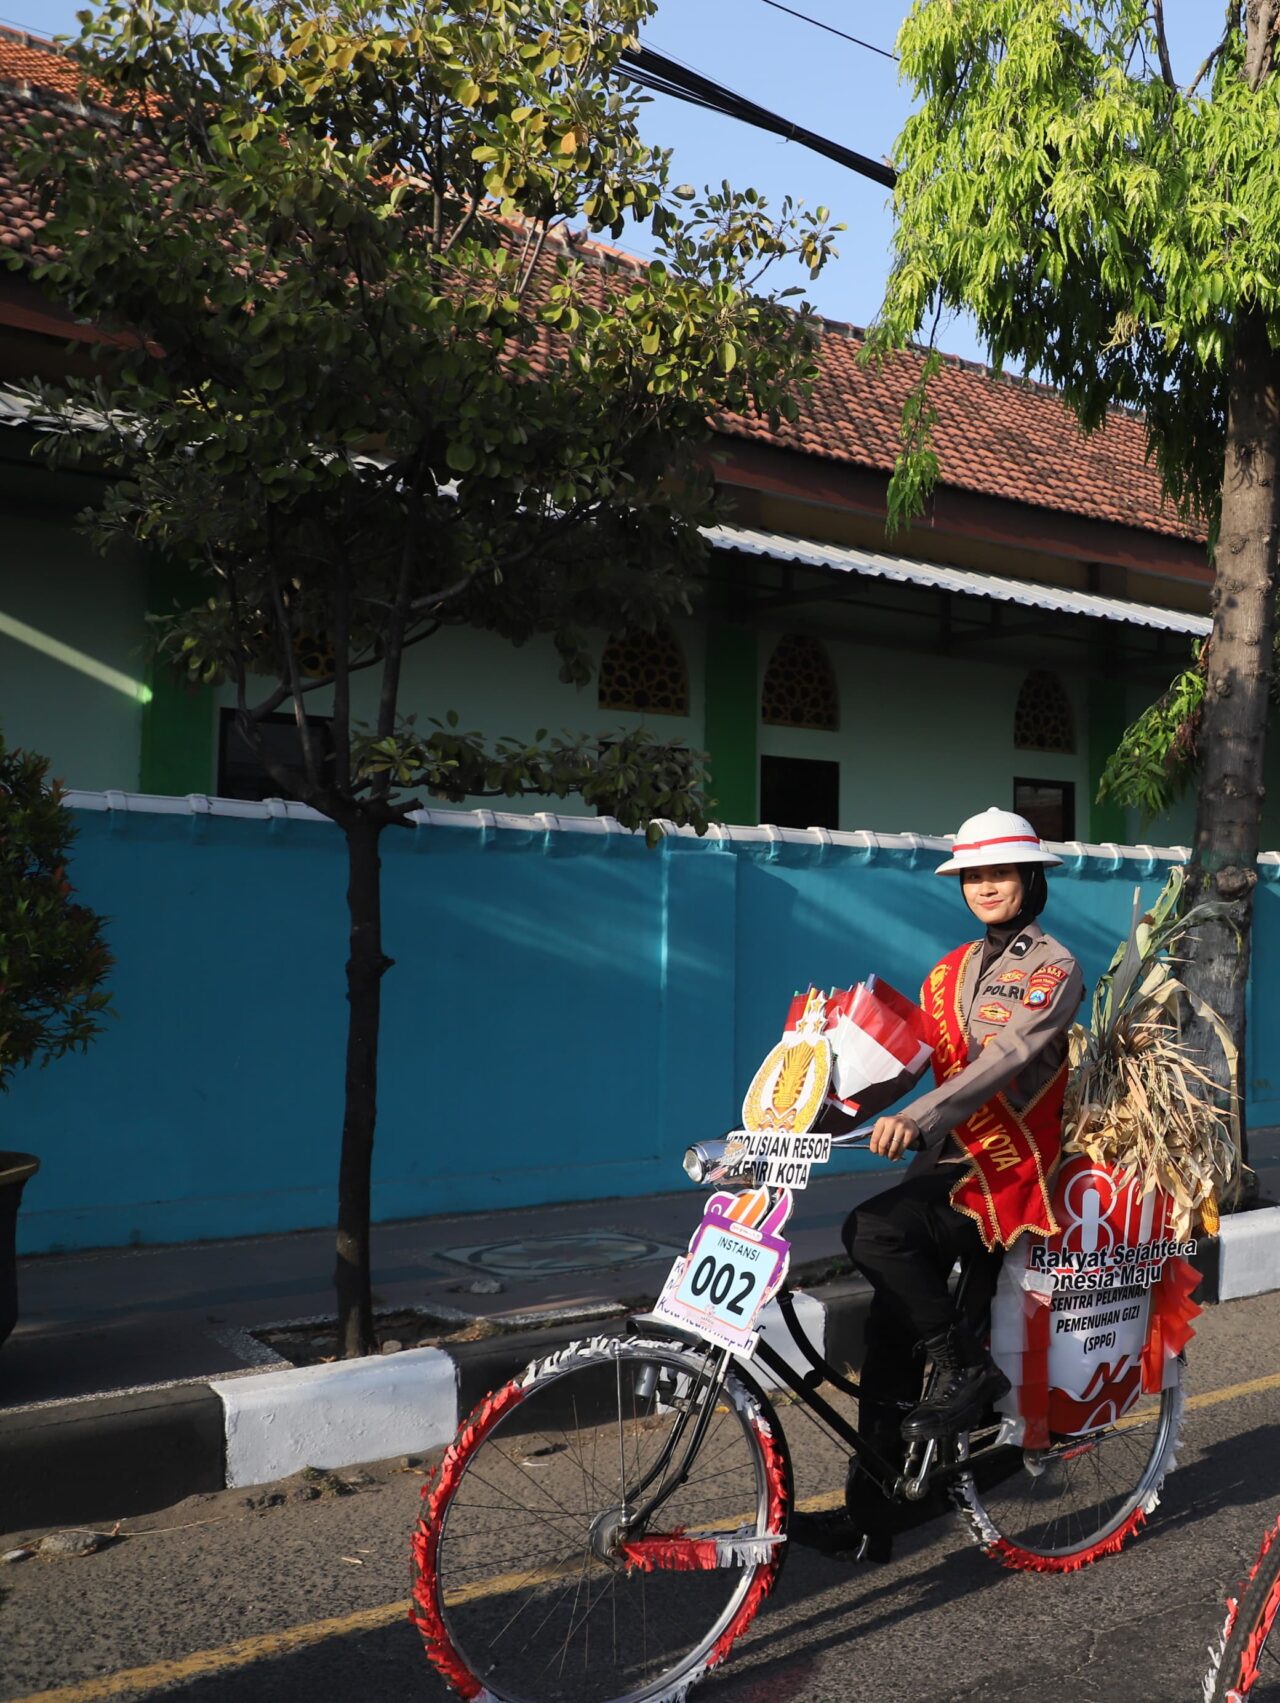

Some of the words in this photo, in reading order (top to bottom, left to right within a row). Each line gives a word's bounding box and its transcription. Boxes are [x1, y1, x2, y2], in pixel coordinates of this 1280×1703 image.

[983, 985, 1025, 1001] POLRI
[792, 1138, 829, 1160] RESOR
[976, 1124, 1022, 1172] KOTA
[775, 1162, 808, 1185] KOTA
[718, 1236, 761, 1262] INSTANSI
[1030, 1245, 1107, 1272] Rakyat
[1113, 1239, 1197, 1266] Sejahtera
[690, 1255, 756, 1316] 002
[1120, 1264, 1162, 1289] Maju
[1051, 1293, 1093, 1312] SENTRA
[1096, 1285, 1147, 1306] PELAYANAN
[1056, 1312, 1120, 1334] PEMENUHAN
[1122, 1305, 1140, 1324] GIZI
[1083, 1331, 1116, 1355] (SPPG)
